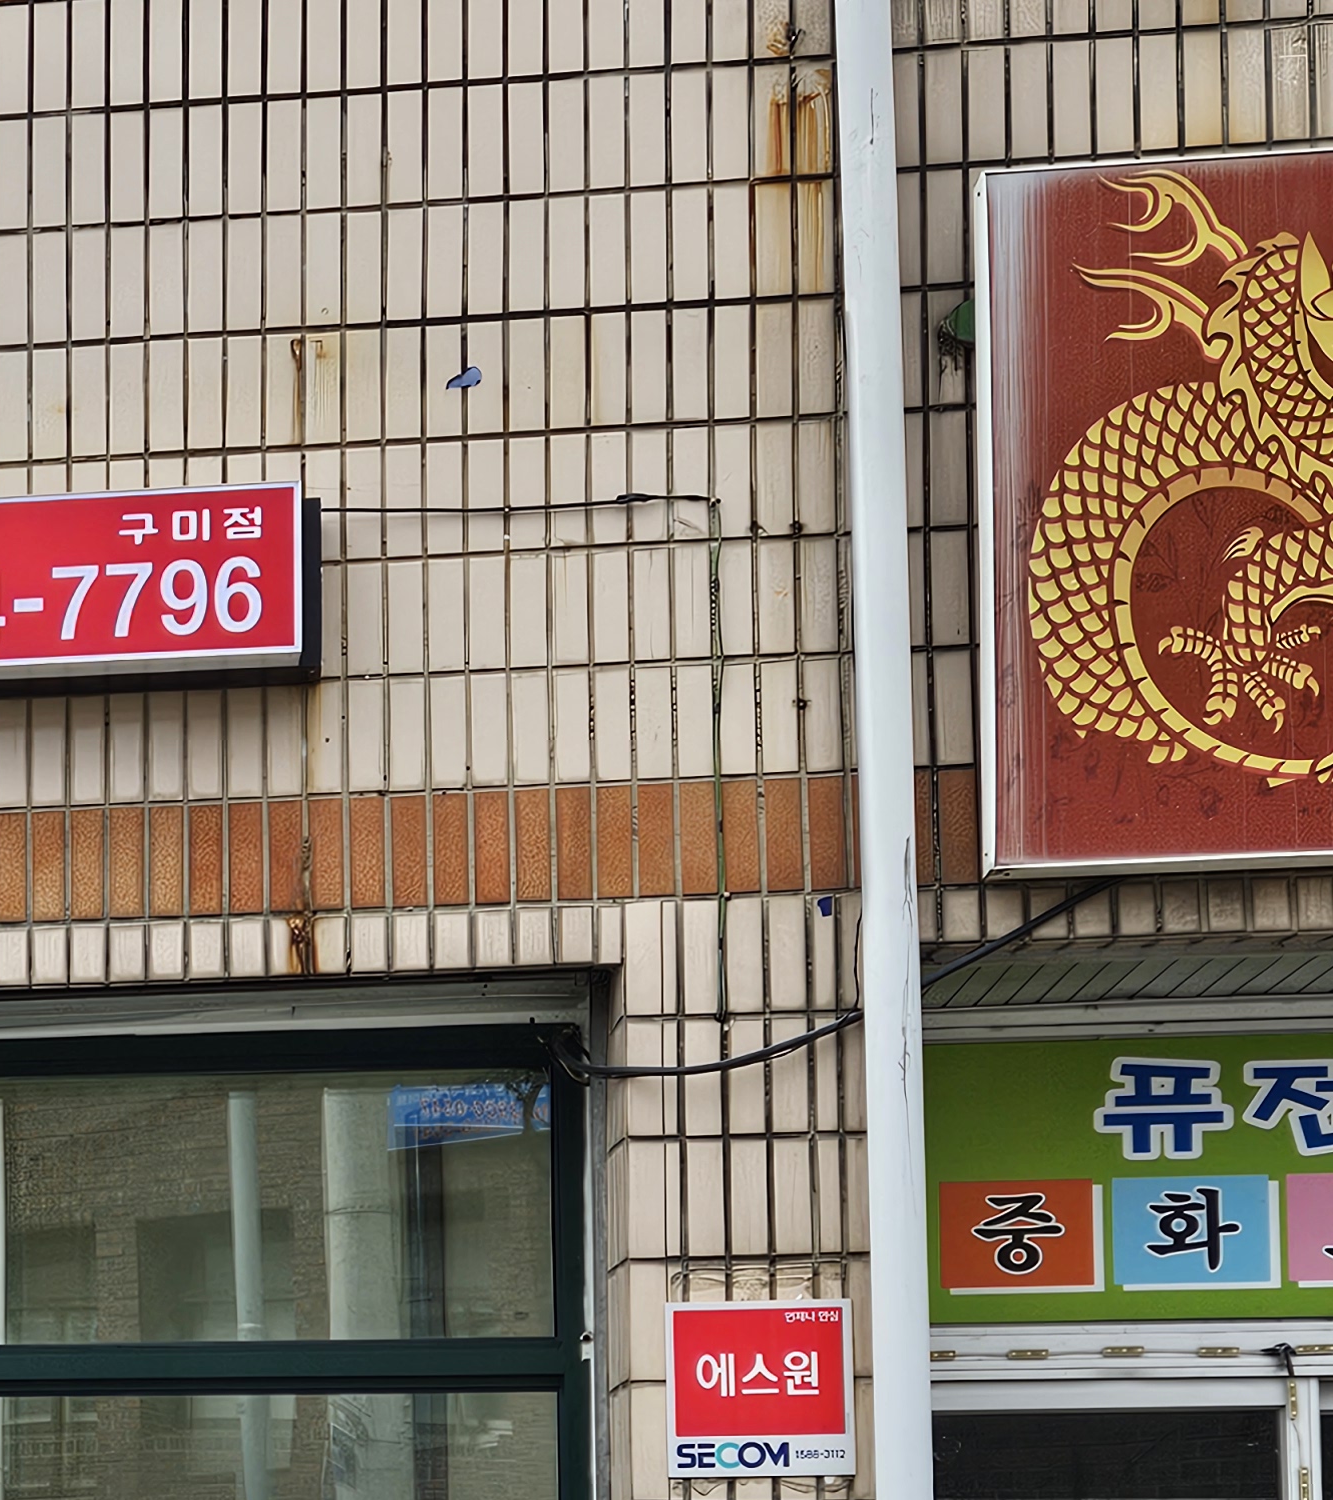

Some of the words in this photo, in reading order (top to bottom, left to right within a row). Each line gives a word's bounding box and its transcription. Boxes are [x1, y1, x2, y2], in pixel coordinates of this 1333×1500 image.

[119, 506, 263, 544] 구미점
[696, 1351, 820, 1397] 에스원
[677, 1442, 789, 1469] SECOM
